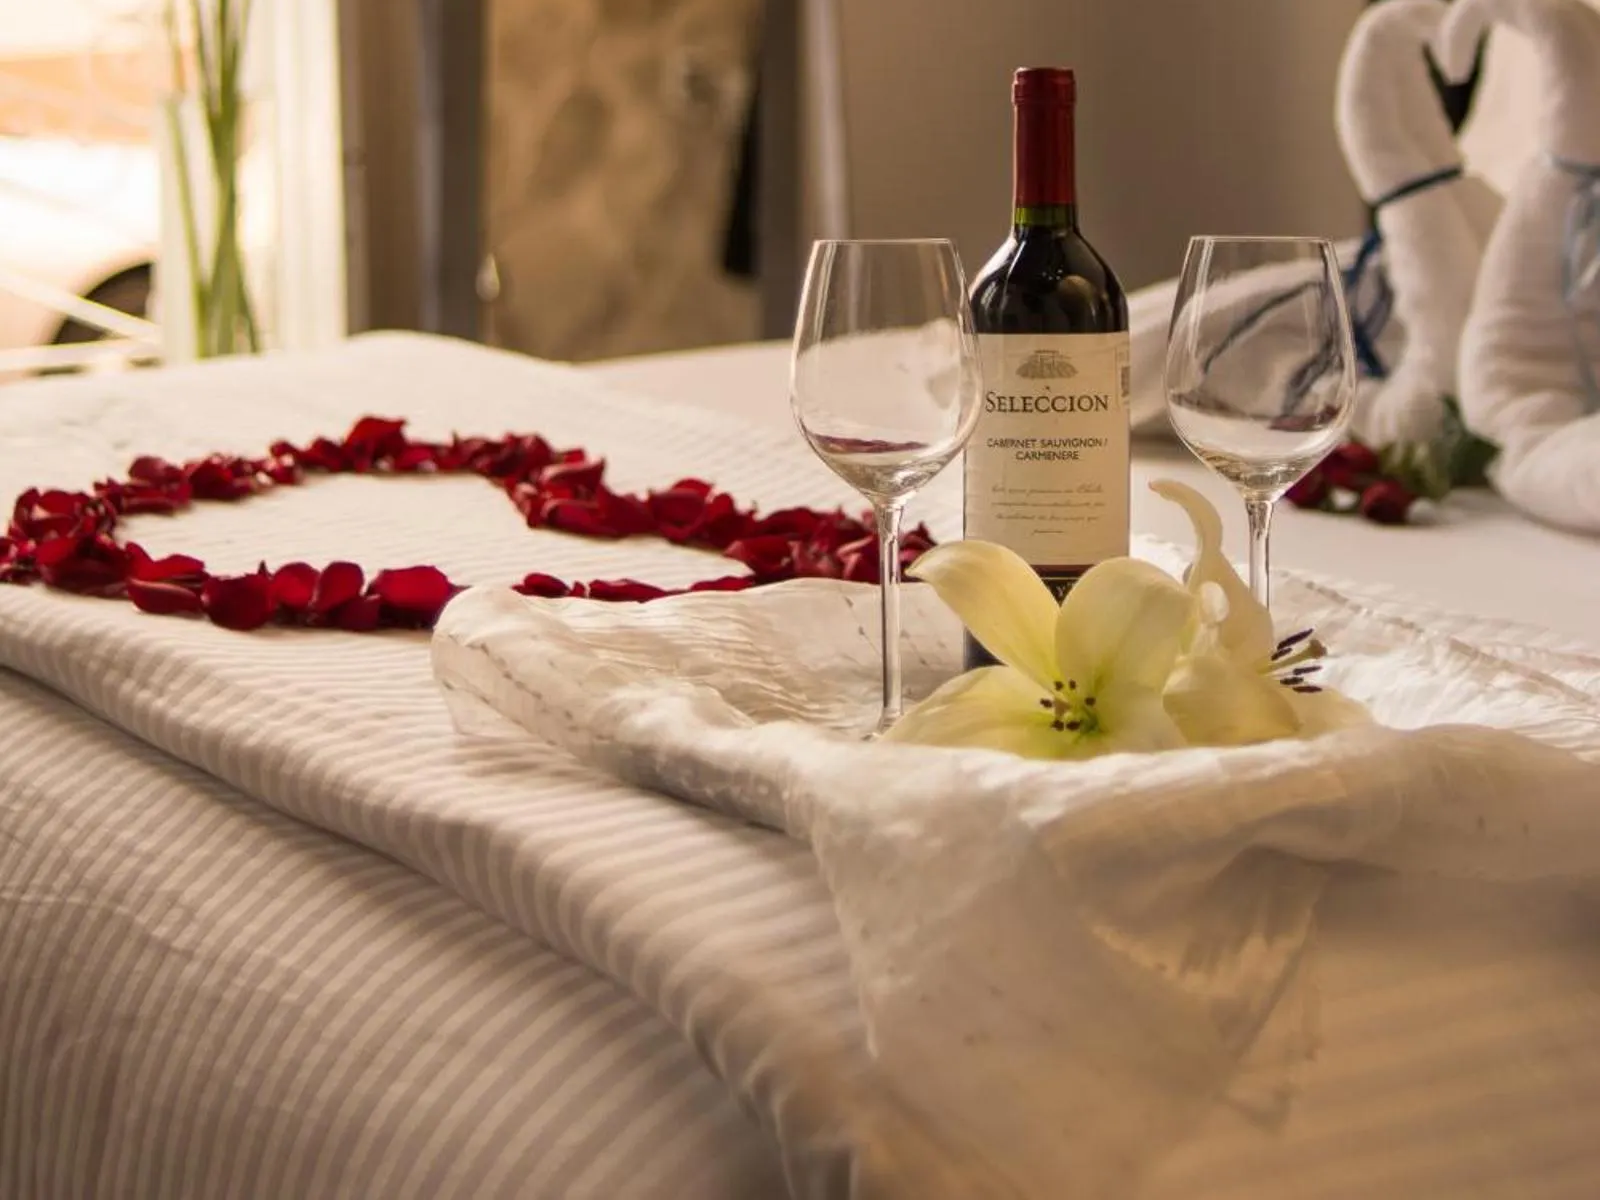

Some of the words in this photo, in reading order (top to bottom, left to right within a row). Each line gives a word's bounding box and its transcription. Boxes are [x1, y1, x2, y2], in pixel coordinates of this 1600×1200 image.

[985, 391, 1109, 413] SELECCION
[986, 438, 1037, 449] CABERNET
[1015, 450, 1080, 461] CARMENERE
